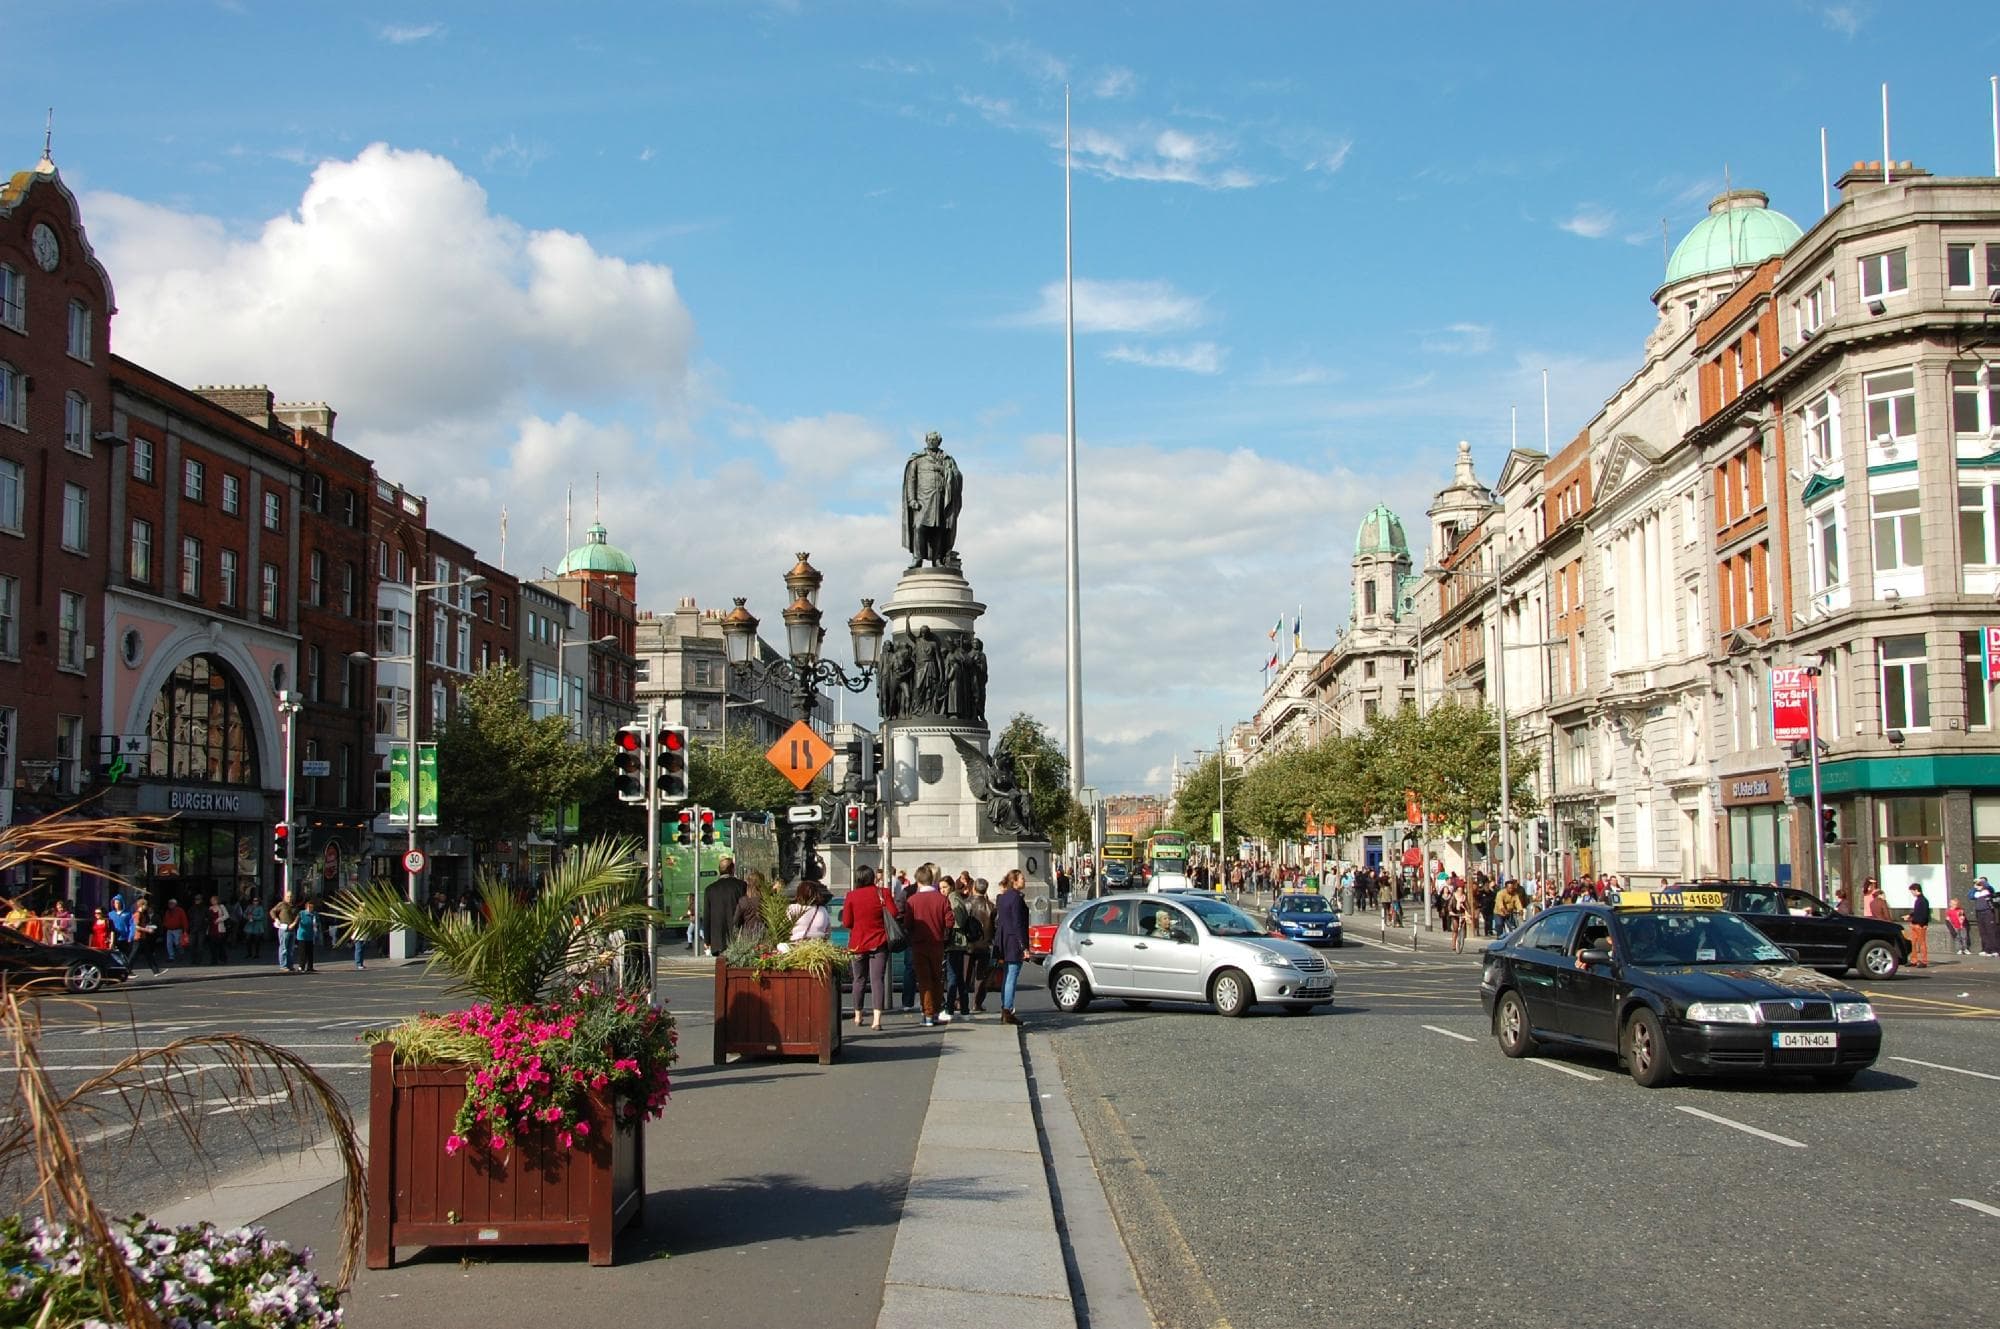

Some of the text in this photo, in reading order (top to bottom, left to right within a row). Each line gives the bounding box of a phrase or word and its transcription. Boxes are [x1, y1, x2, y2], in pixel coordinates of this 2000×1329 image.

[1773, 670, 1800, 684] DTZ
[1774, 691, 1789, 700] For
[1774, 699, 1801, 708] To Let
[1753, 780, 1769, 795] Bank
[171, 791, 240, 812] BURGER KING
[409, 853, 421, 864] 30
[1651, 893, 1721, 905] TAXI 41680
